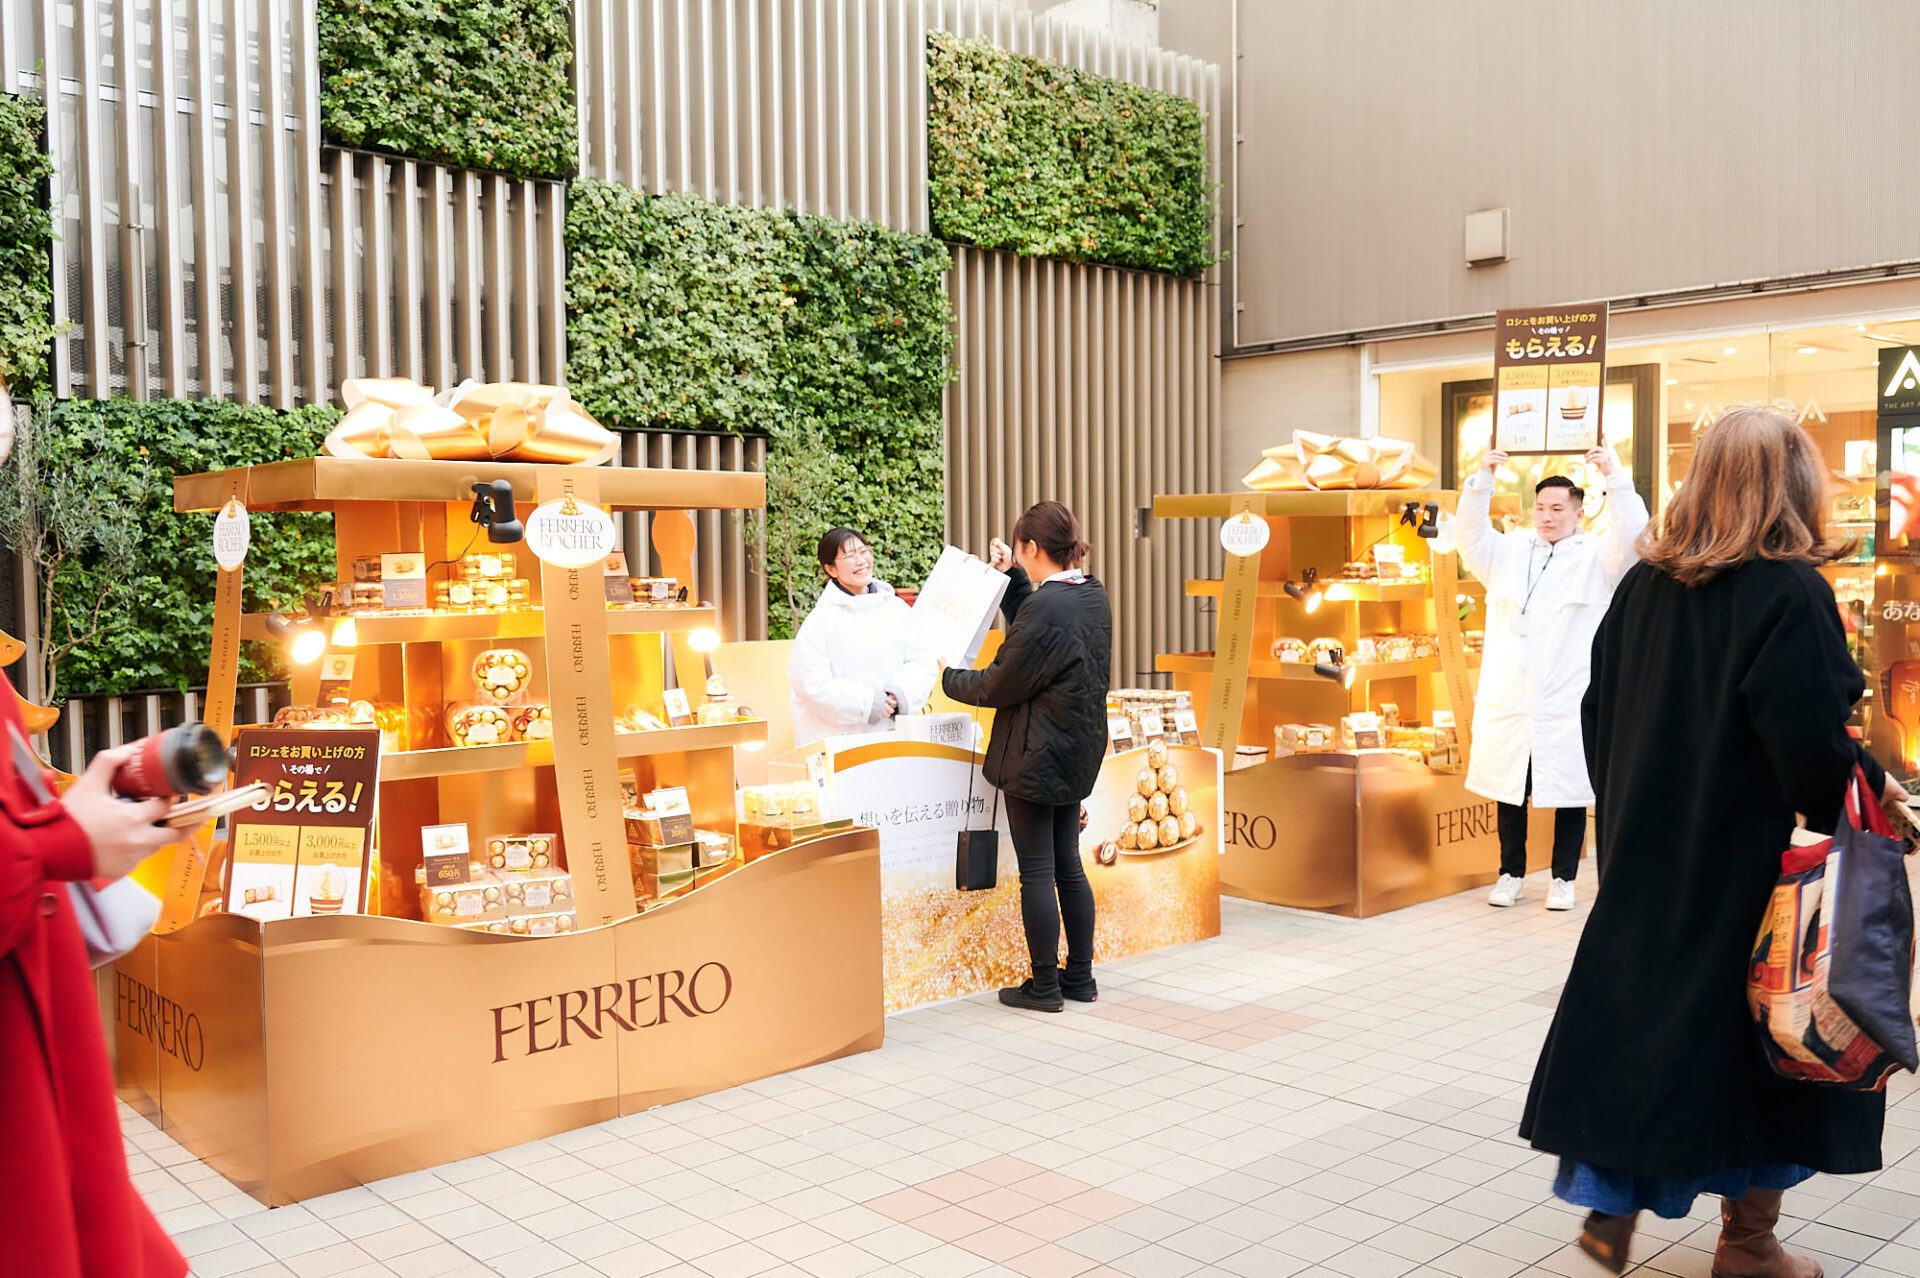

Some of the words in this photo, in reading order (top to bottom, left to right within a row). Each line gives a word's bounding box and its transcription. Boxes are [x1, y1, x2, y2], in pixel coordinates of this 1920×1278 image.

[1505, 313, 1597, 326] ロシェをお買い上げの方
[540, 517, 603, 534] FERRERO
[541, 534, 603, 549] ROCHER
[571, 624, 583, 673] FERRERO
[576, 696, 590, 746] FERRERO
[250, 745, 366, 760] ロシェをお買い上げの方
[289, 764, 323, 776] その場で
[583, 769, 597, 819] FERRERO
[592, 842, 607, 892] FERRERO
[116, 971, 204, 1071] FERRERO
[488, 961, 732, 1064] FERRERO
